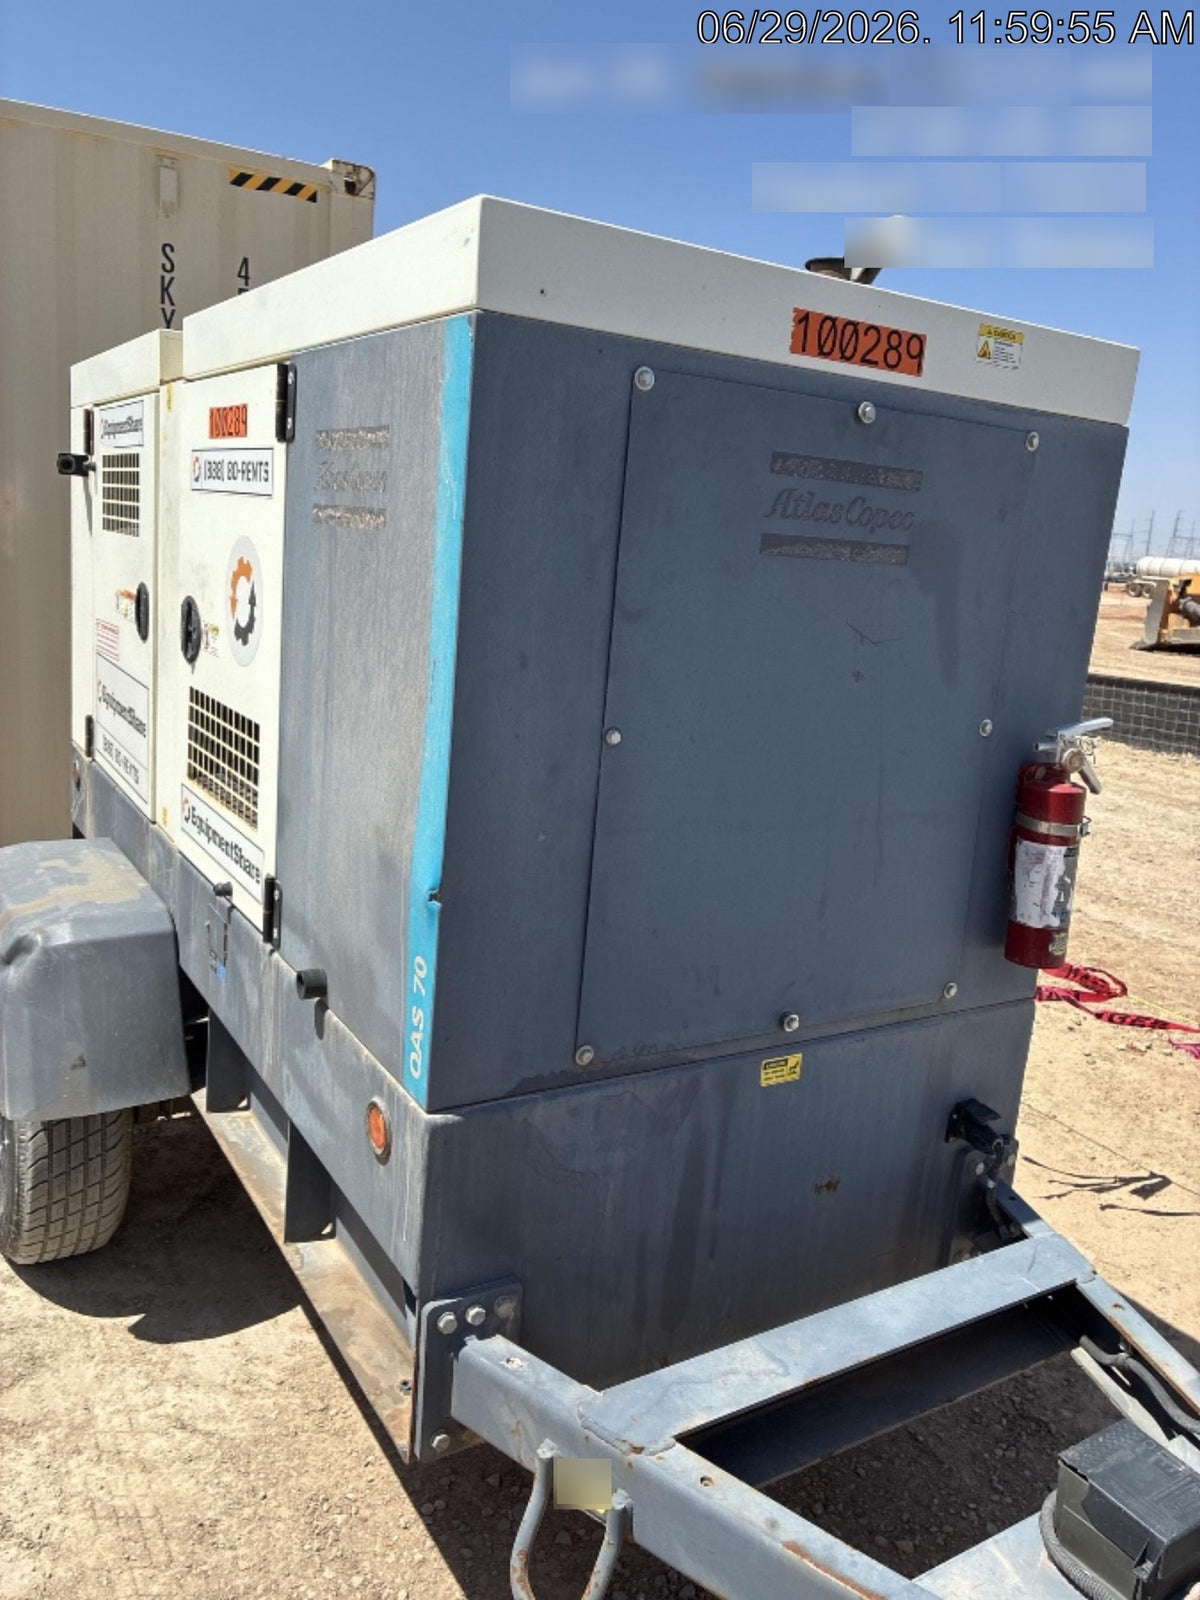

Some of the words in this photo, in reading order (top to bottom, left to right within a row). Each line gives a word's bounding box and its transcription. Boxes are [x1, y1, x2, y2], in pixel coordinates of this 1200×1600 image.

[237, 256, 251, 295] 4
[797, 311, 926, 374] 100289
[191, 805, 261, 885] EquipmentShare
[413, 955, 428, 996] 70
[409, 1005, 424, 1080] QAS
